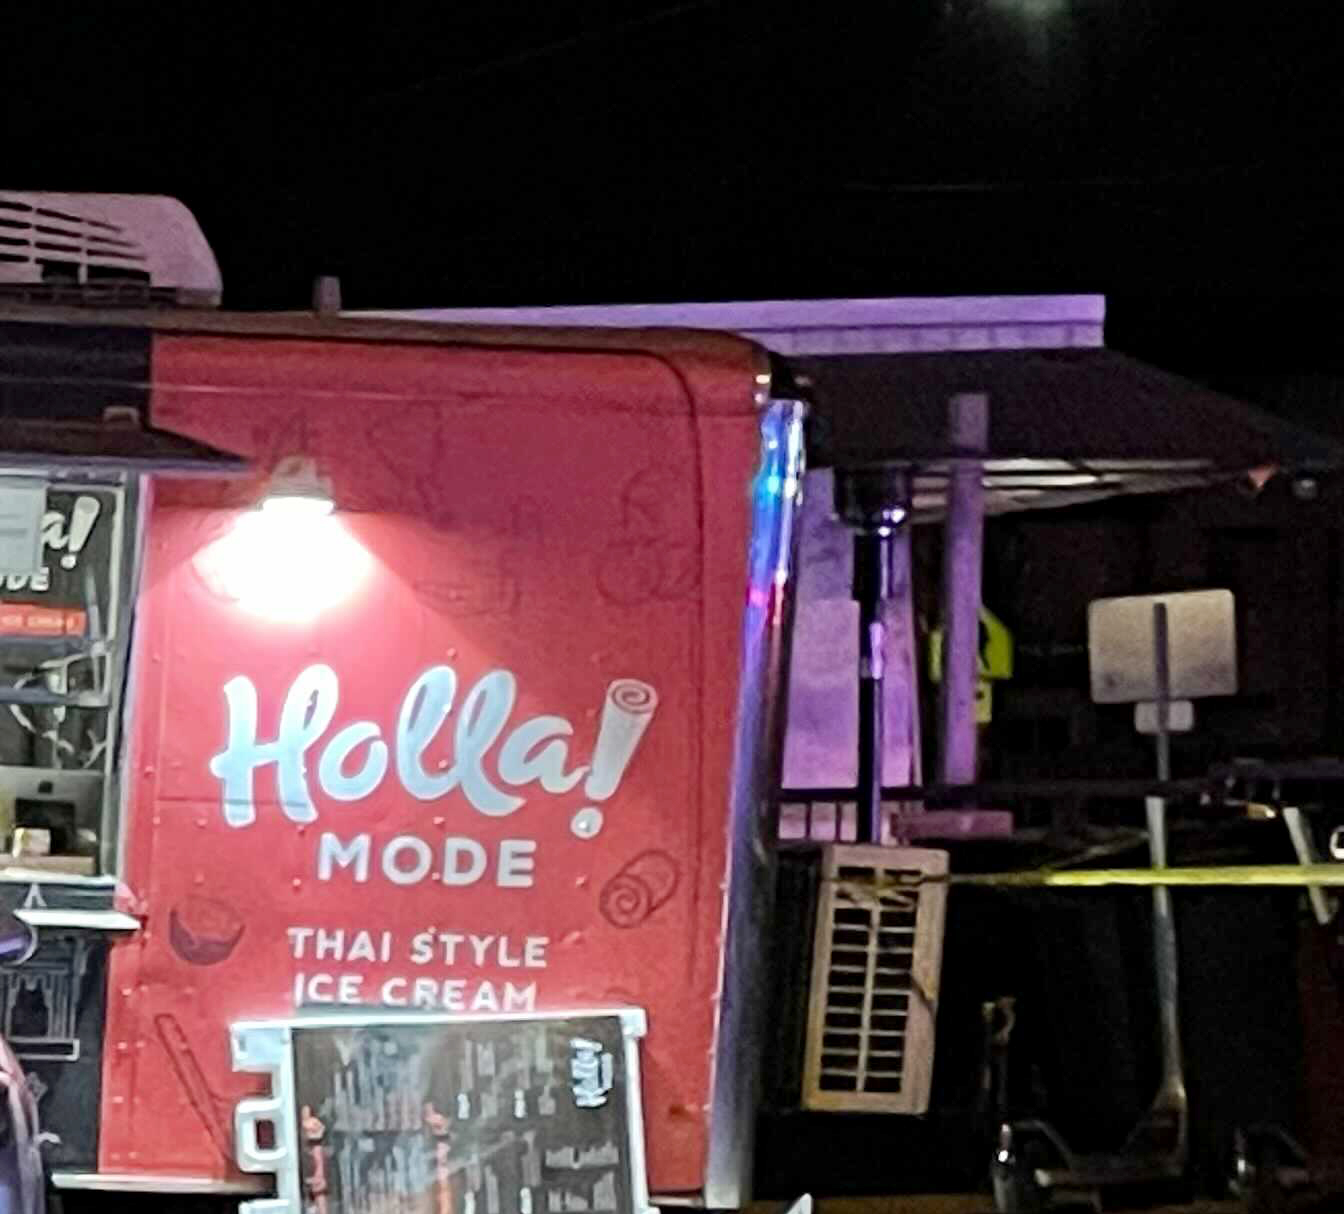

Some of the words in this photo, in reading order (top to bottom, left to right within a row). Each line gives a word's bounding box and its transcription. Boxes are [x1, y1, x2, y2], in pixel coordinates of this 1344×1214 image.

[210, 663, 658, 838] Holla!
[317, 832, 537, 888] MODE
[287, 927, 391, 963] THAI
[410, 930, 550, 968] STYLE
[293, 973, 364, 1007] ICE
[382, 977, 537, 1013] CREAM
